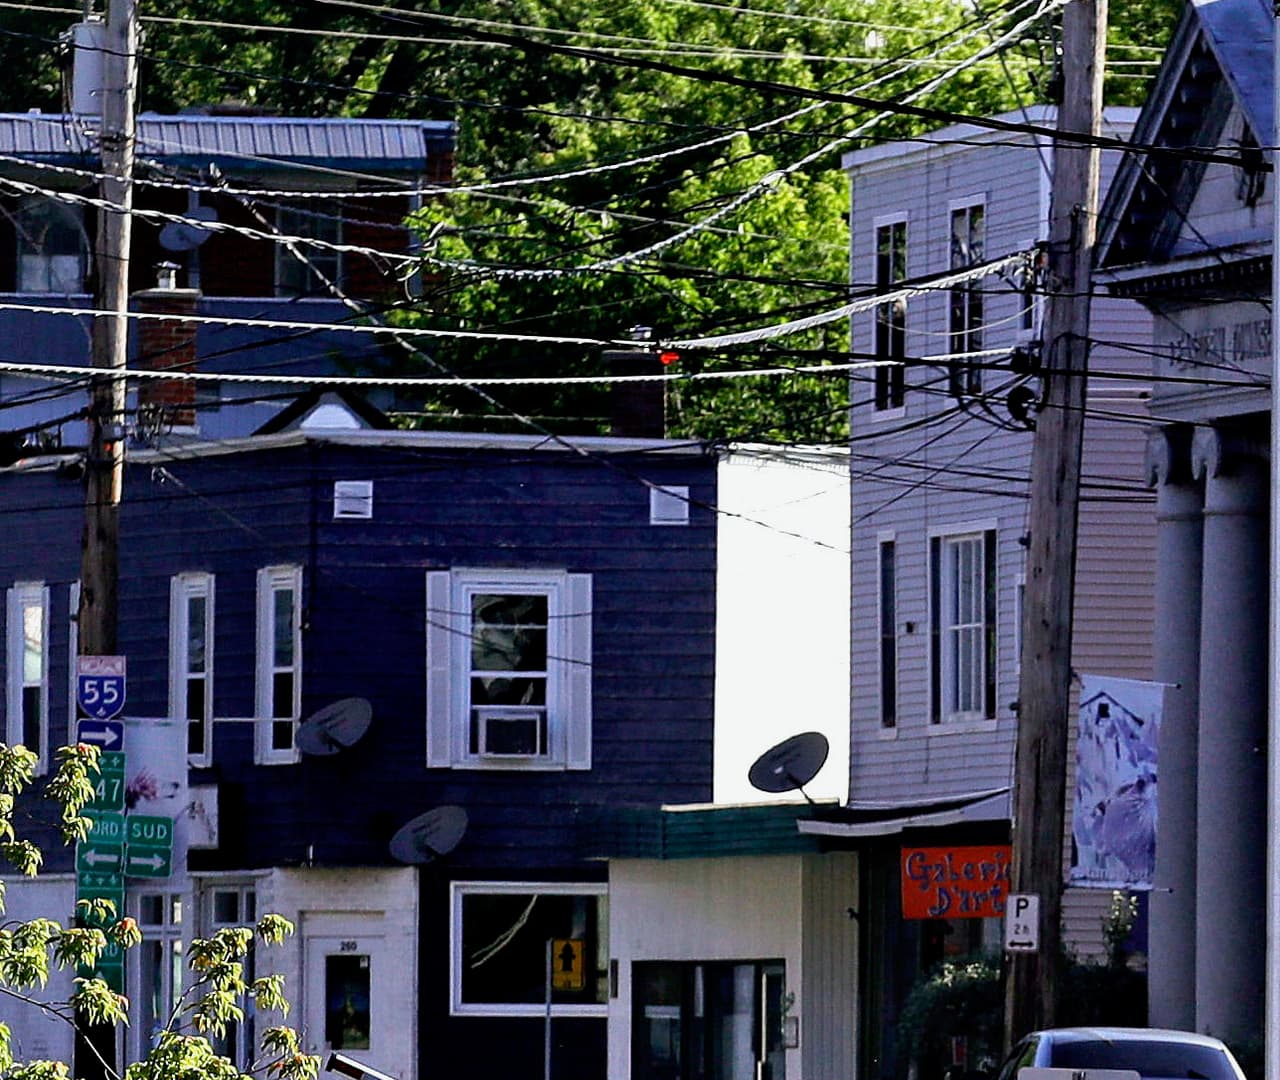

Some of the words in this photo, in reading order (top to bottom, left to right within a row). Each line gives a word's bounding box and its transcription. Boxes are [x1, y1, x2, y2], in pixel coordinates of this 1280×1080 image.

[84, 679, 119, 705] 55
[94, 778, 120, 802] 47
[92, 822, 119, 838] ORD
[131, 822, 168, 840] SUD
[1015, 897, 1029, 918] P
